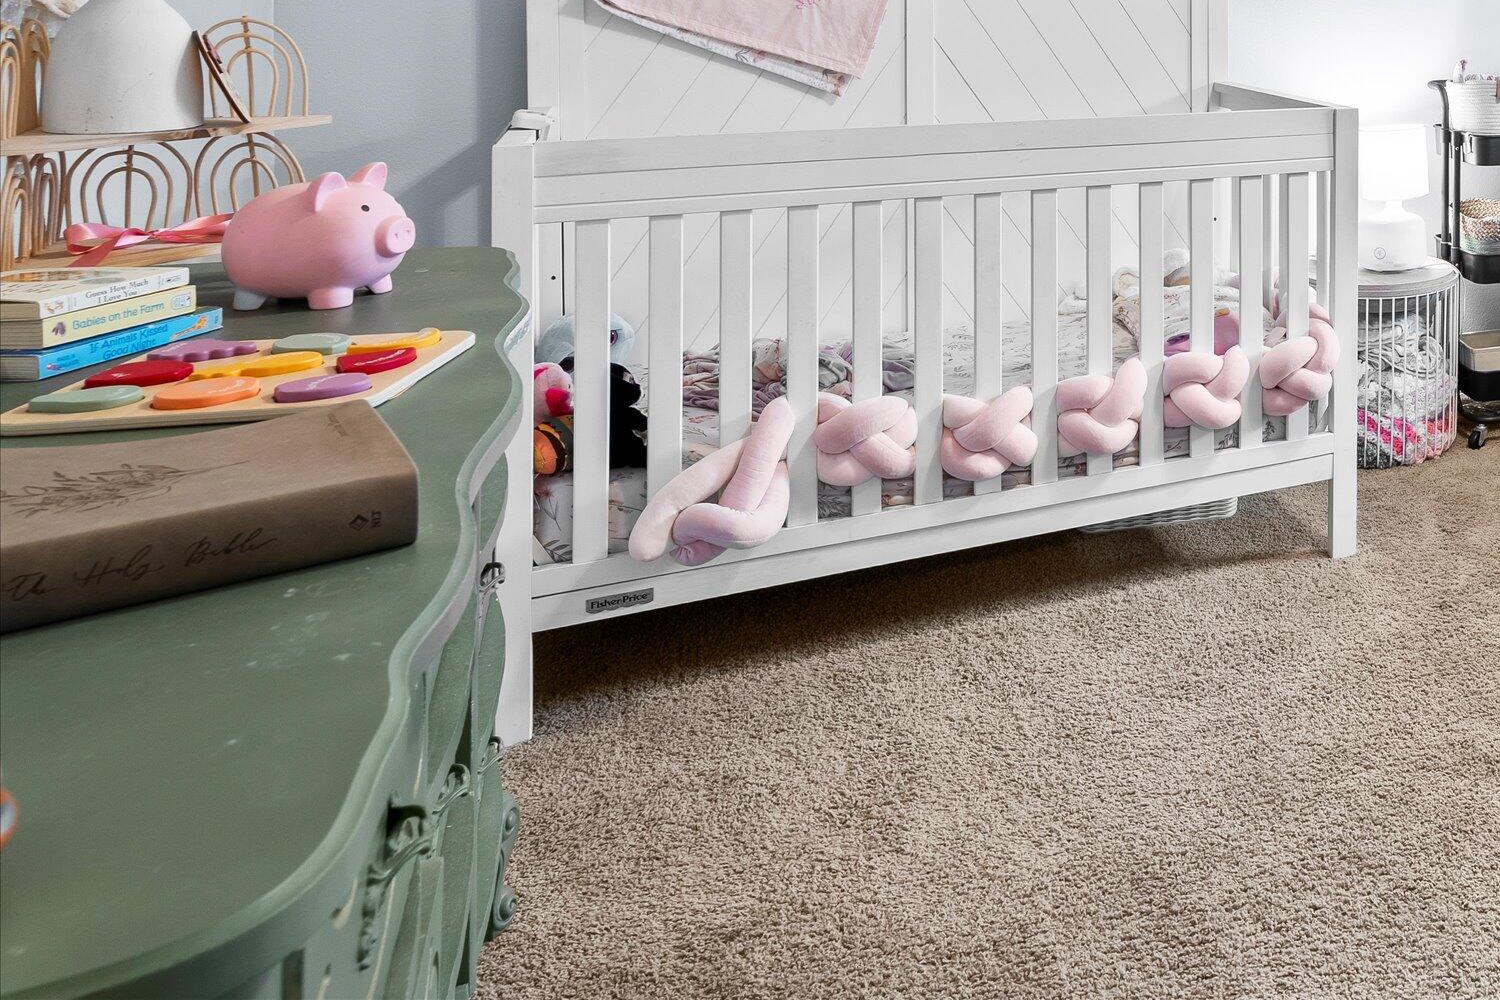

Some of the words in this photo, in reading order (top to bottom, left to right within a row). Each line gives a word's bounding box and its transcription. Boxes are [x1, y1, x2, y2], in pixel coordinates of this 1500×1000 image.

[85, 289, 108, 298] Guess
[110, 285, 126, 293] How
[129, 279, 149, 288] Much
[103, 294, 121, 302] Love
[72, 315, 106, 330] Babies
[108, 312, 120, 322] on
[123, 308, 138, 318] the
[140, 302, 165, 314] Farm
[89, 342, 99, 353] If
[101, 332, 137, 348] Animals
[140, 323, 168, 338] Kissed
[103, 345, 128, 360] Good
[130, 338, 156, 351] Night
[3, 571, 56, 601] The
[73, 544, 165, 588] Holy
[184, 527, 278, 568] Bible
